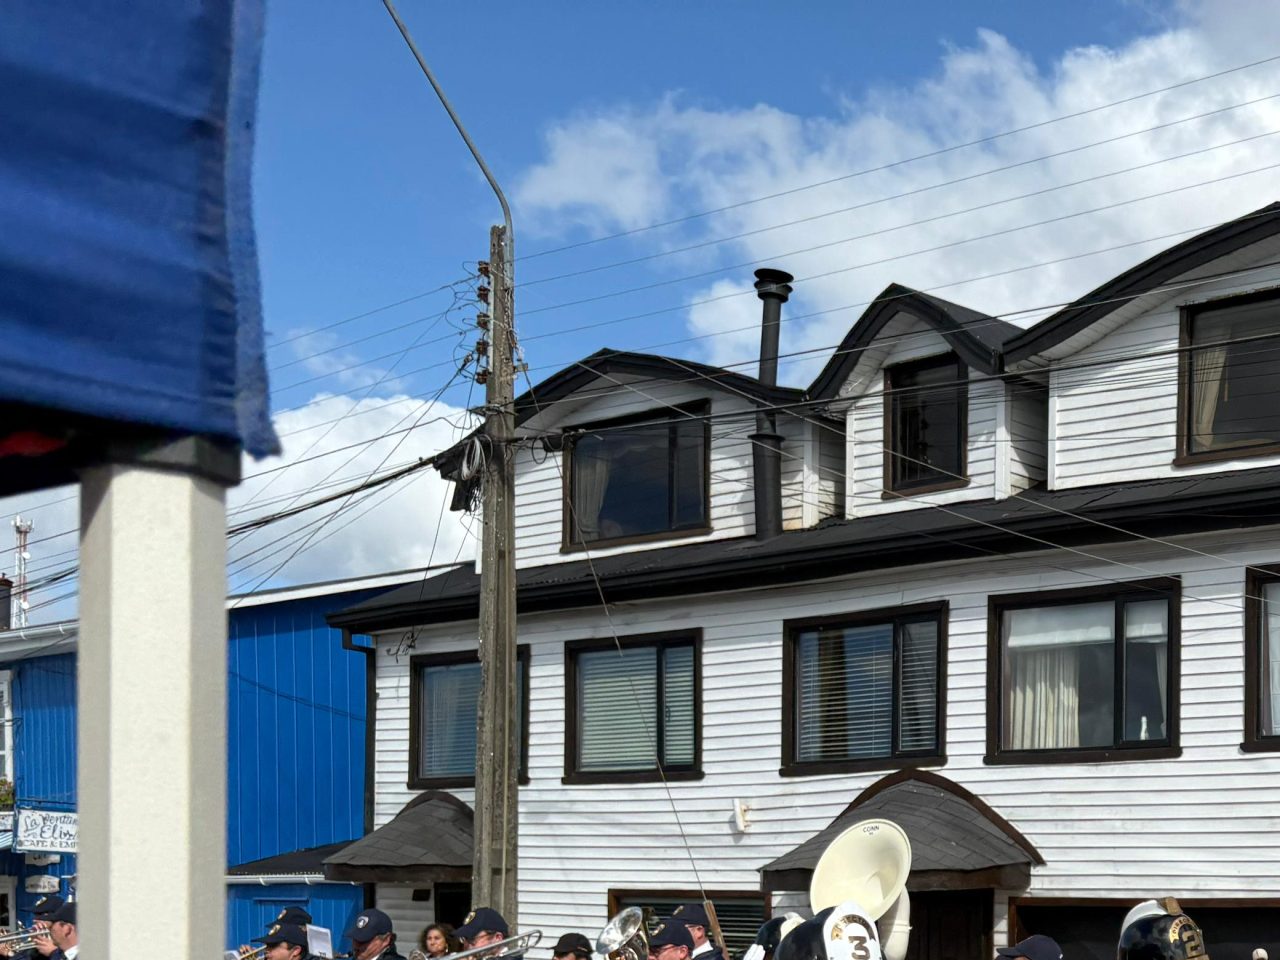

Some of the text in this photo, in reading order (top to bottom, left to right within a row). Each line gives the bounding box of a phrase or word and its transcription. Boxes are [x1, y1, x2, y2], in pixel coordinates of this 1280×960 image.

[24, 815, 40, 833] La
[862, 824, 880, 833] CONN
[848, 935, 871, 960] 3
[1182, 930, 1205, 957] 2
